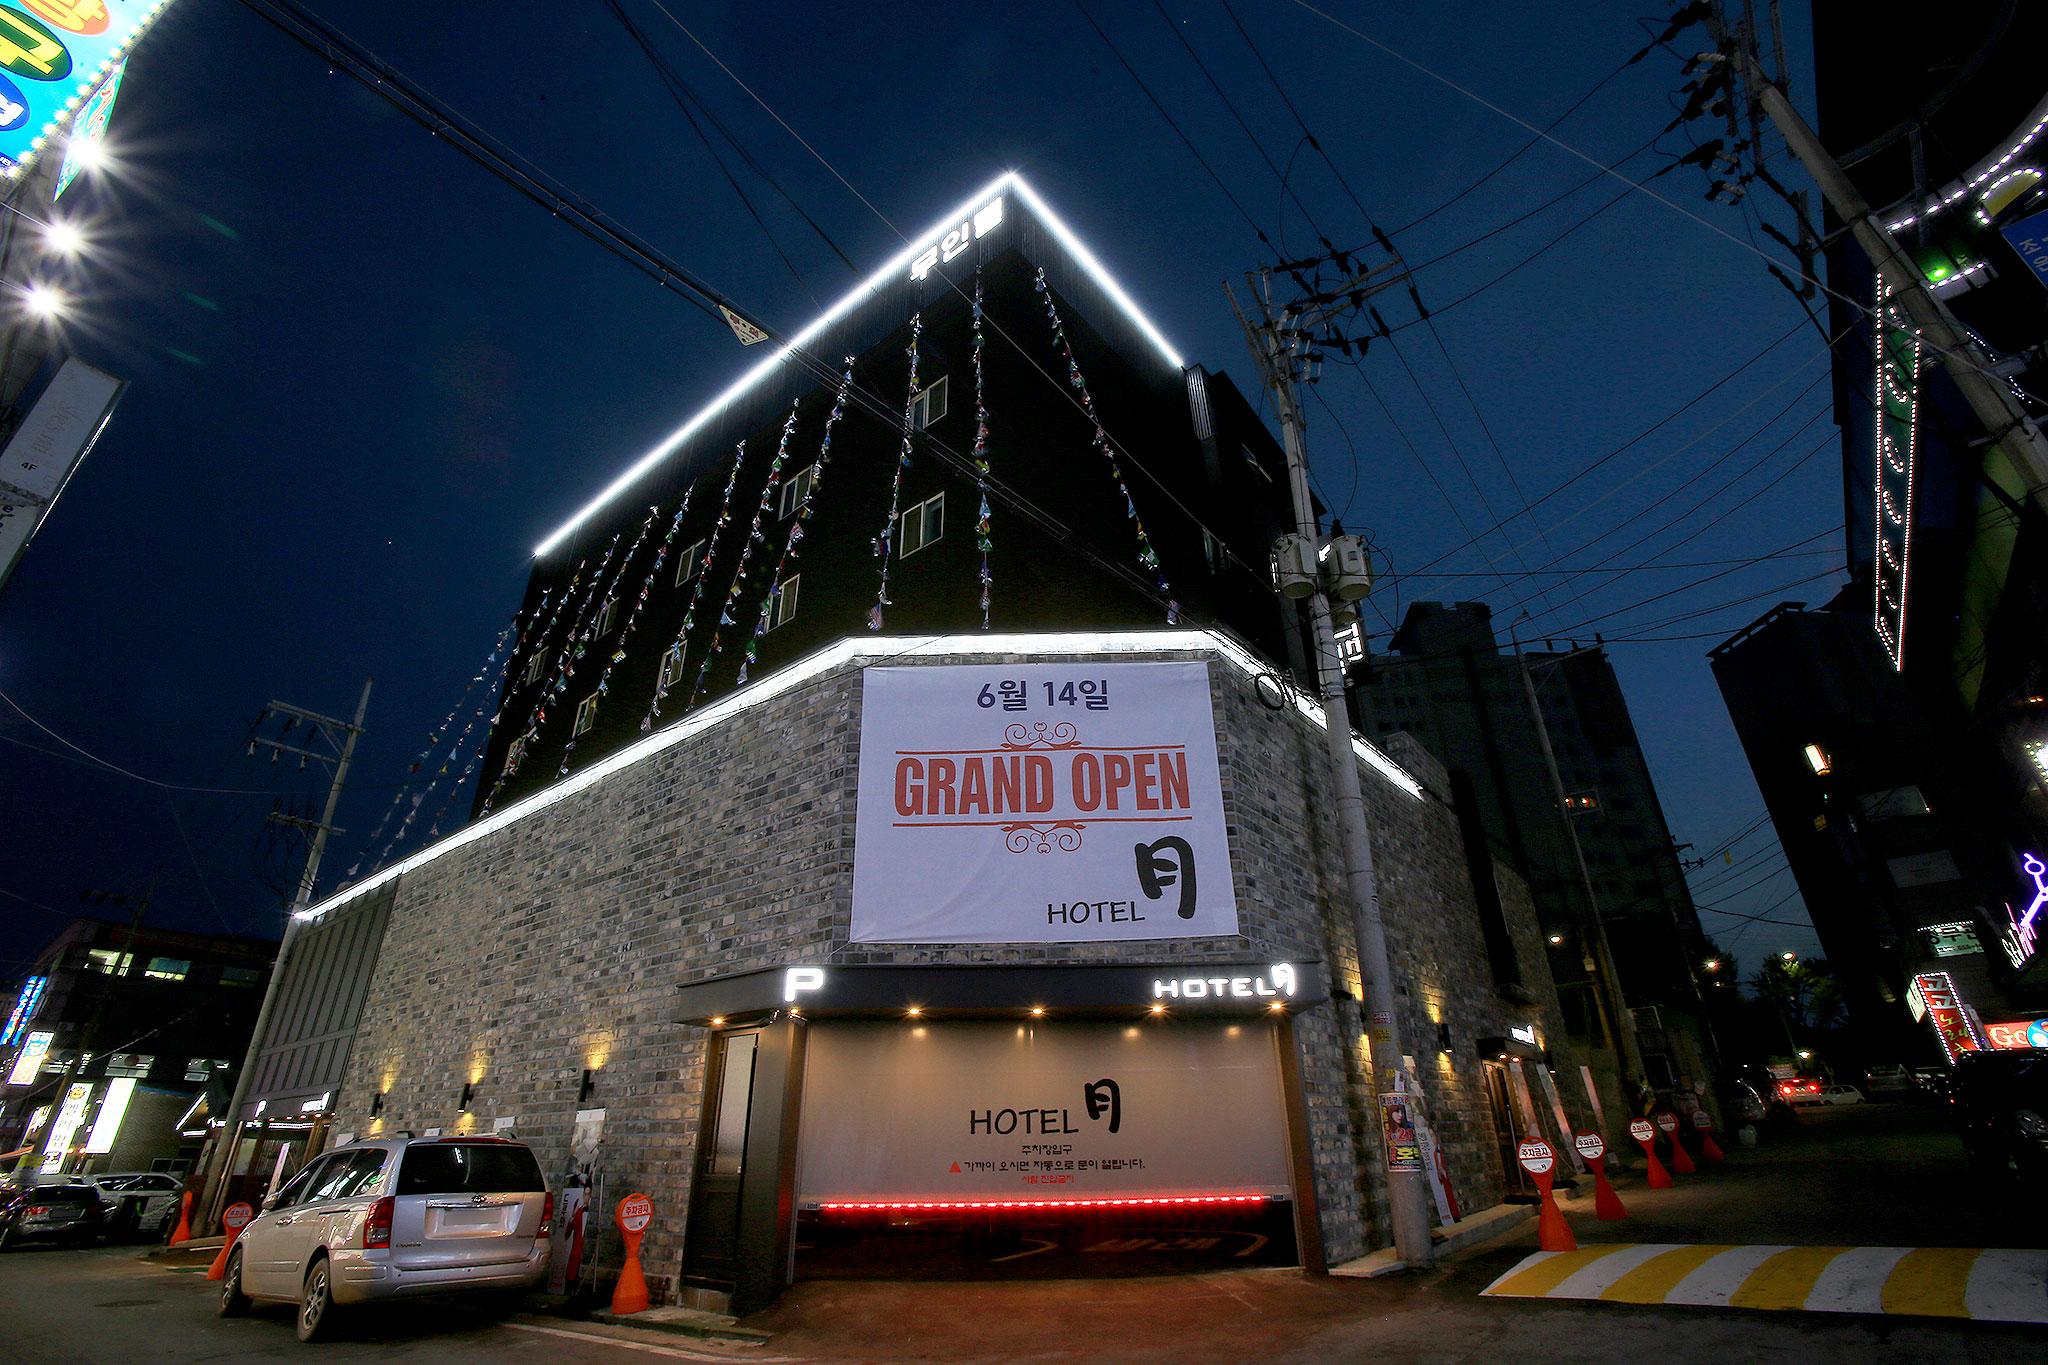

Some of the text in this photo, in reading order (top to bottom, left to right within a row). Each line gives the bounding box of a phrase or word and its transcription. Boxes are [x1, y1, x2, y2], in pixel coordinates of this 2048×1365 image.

[910, 196, 1003, 282] 무인
[976, 679, 1110, 712] 6월 14일
[894, 752, 1191, 817] GRAND OPEN
[1047, 901, 1146, 924] HOTEL
[784, 967, 824, 1002] P
[1153, 976, 1278, 999] HOTEL
[970, 1108, 1079, 1135] HOTEL
[1021, 1144, 1073, 1156] 주차장입구
[964, 1161, 996, 1172] 가까이
[998, 1160, 1030, 1172] 오시면
[1033, 1160, 1075, 1172] 자동으로
[1077, 1160, 1098, 1171] 문이
